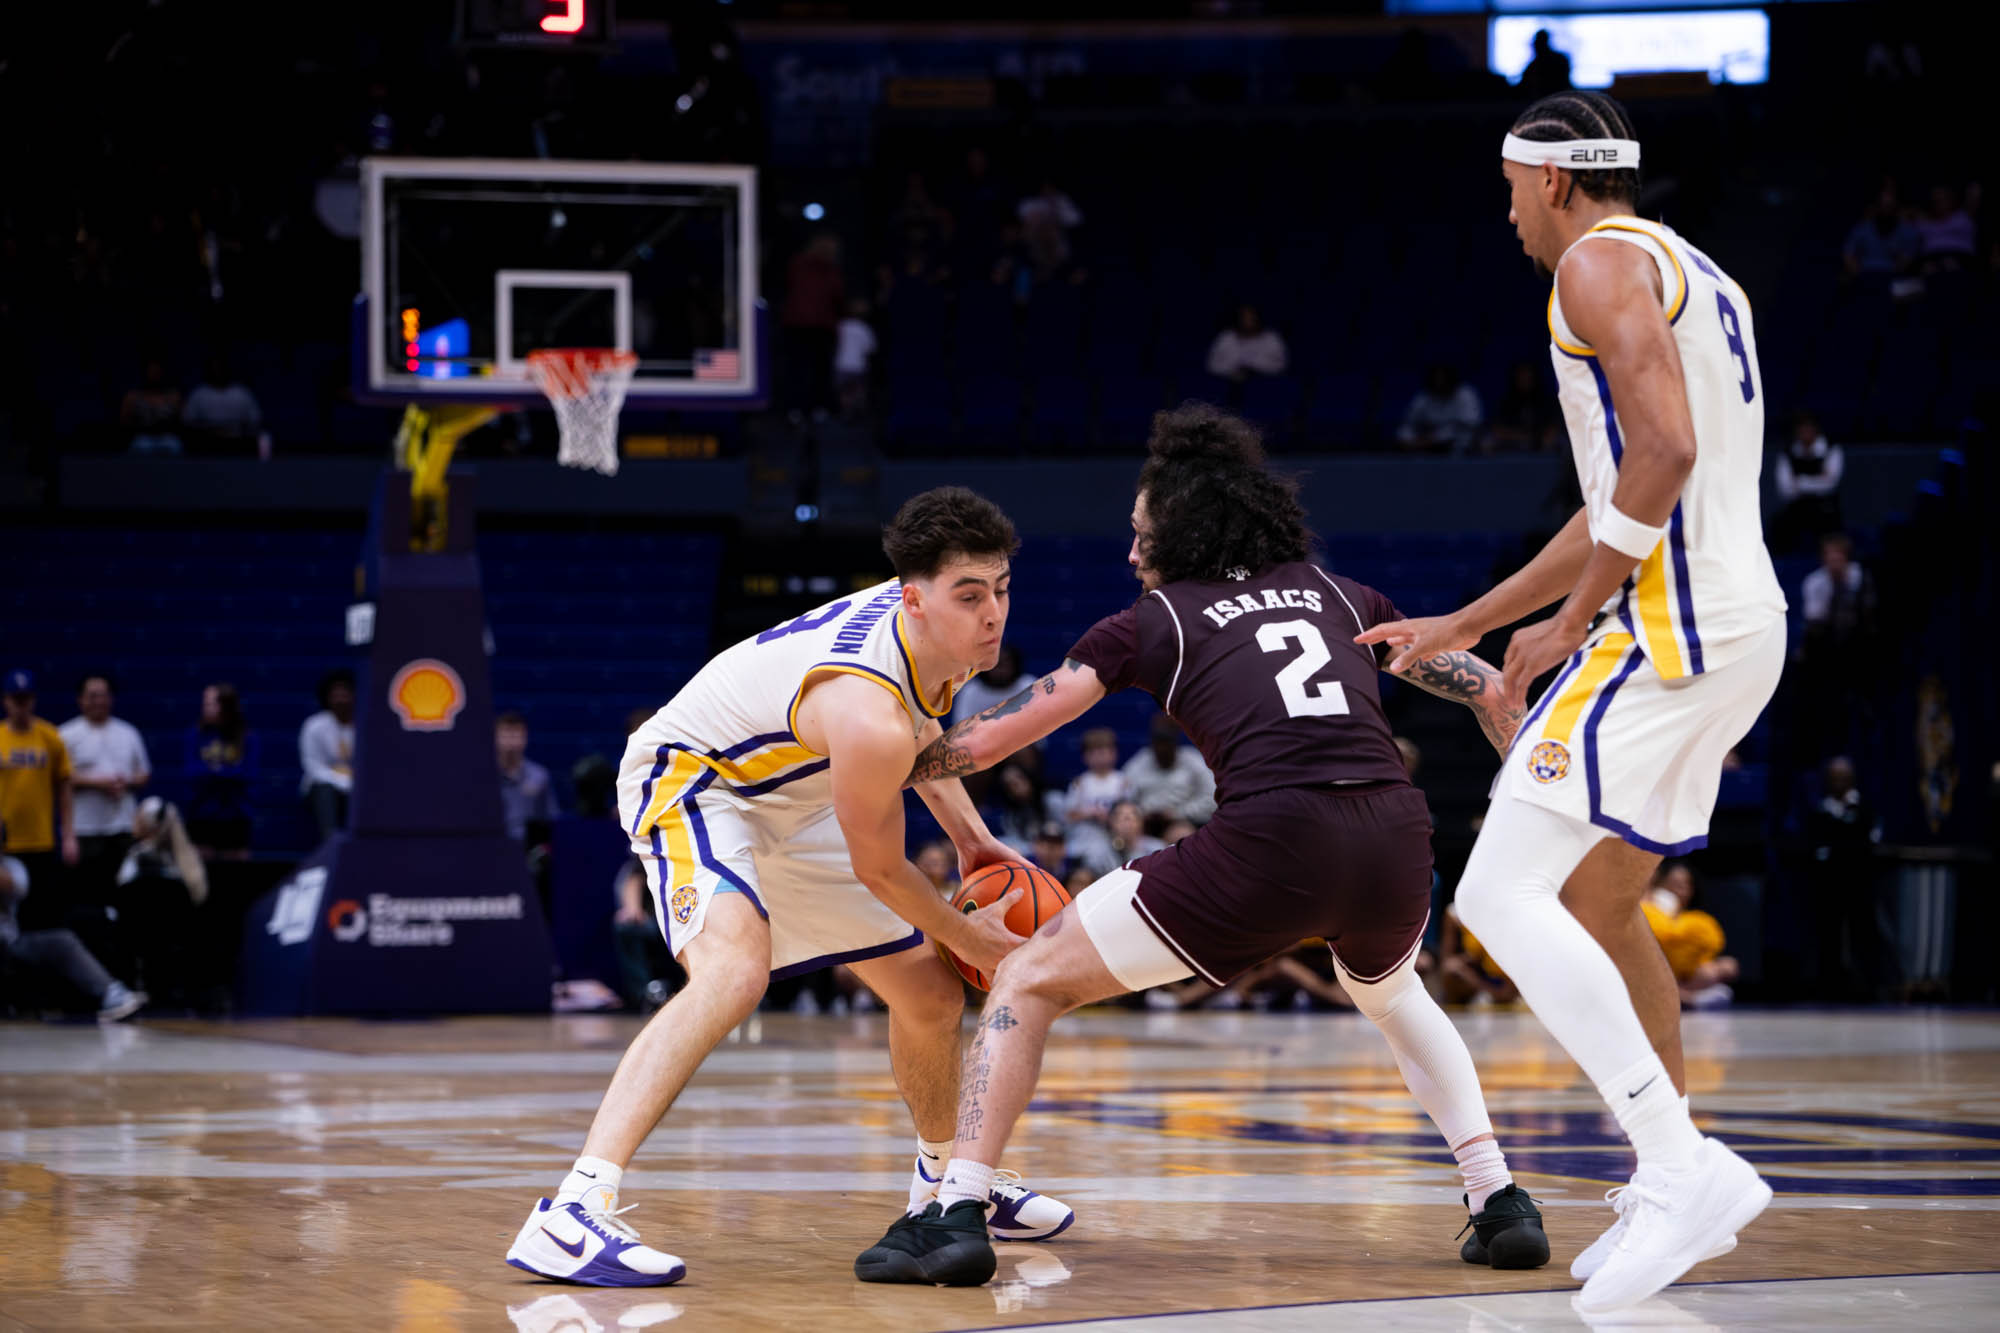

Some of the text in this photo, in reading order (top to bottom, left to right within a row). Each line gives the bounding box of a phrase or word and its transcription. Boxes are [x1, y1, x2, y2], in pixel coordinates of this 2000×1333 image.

[830, 583, 903, 654] ACKINNON
[1202, 589, 1322, 628] ISAACS
[1255, 619, 1350, 718] 2
